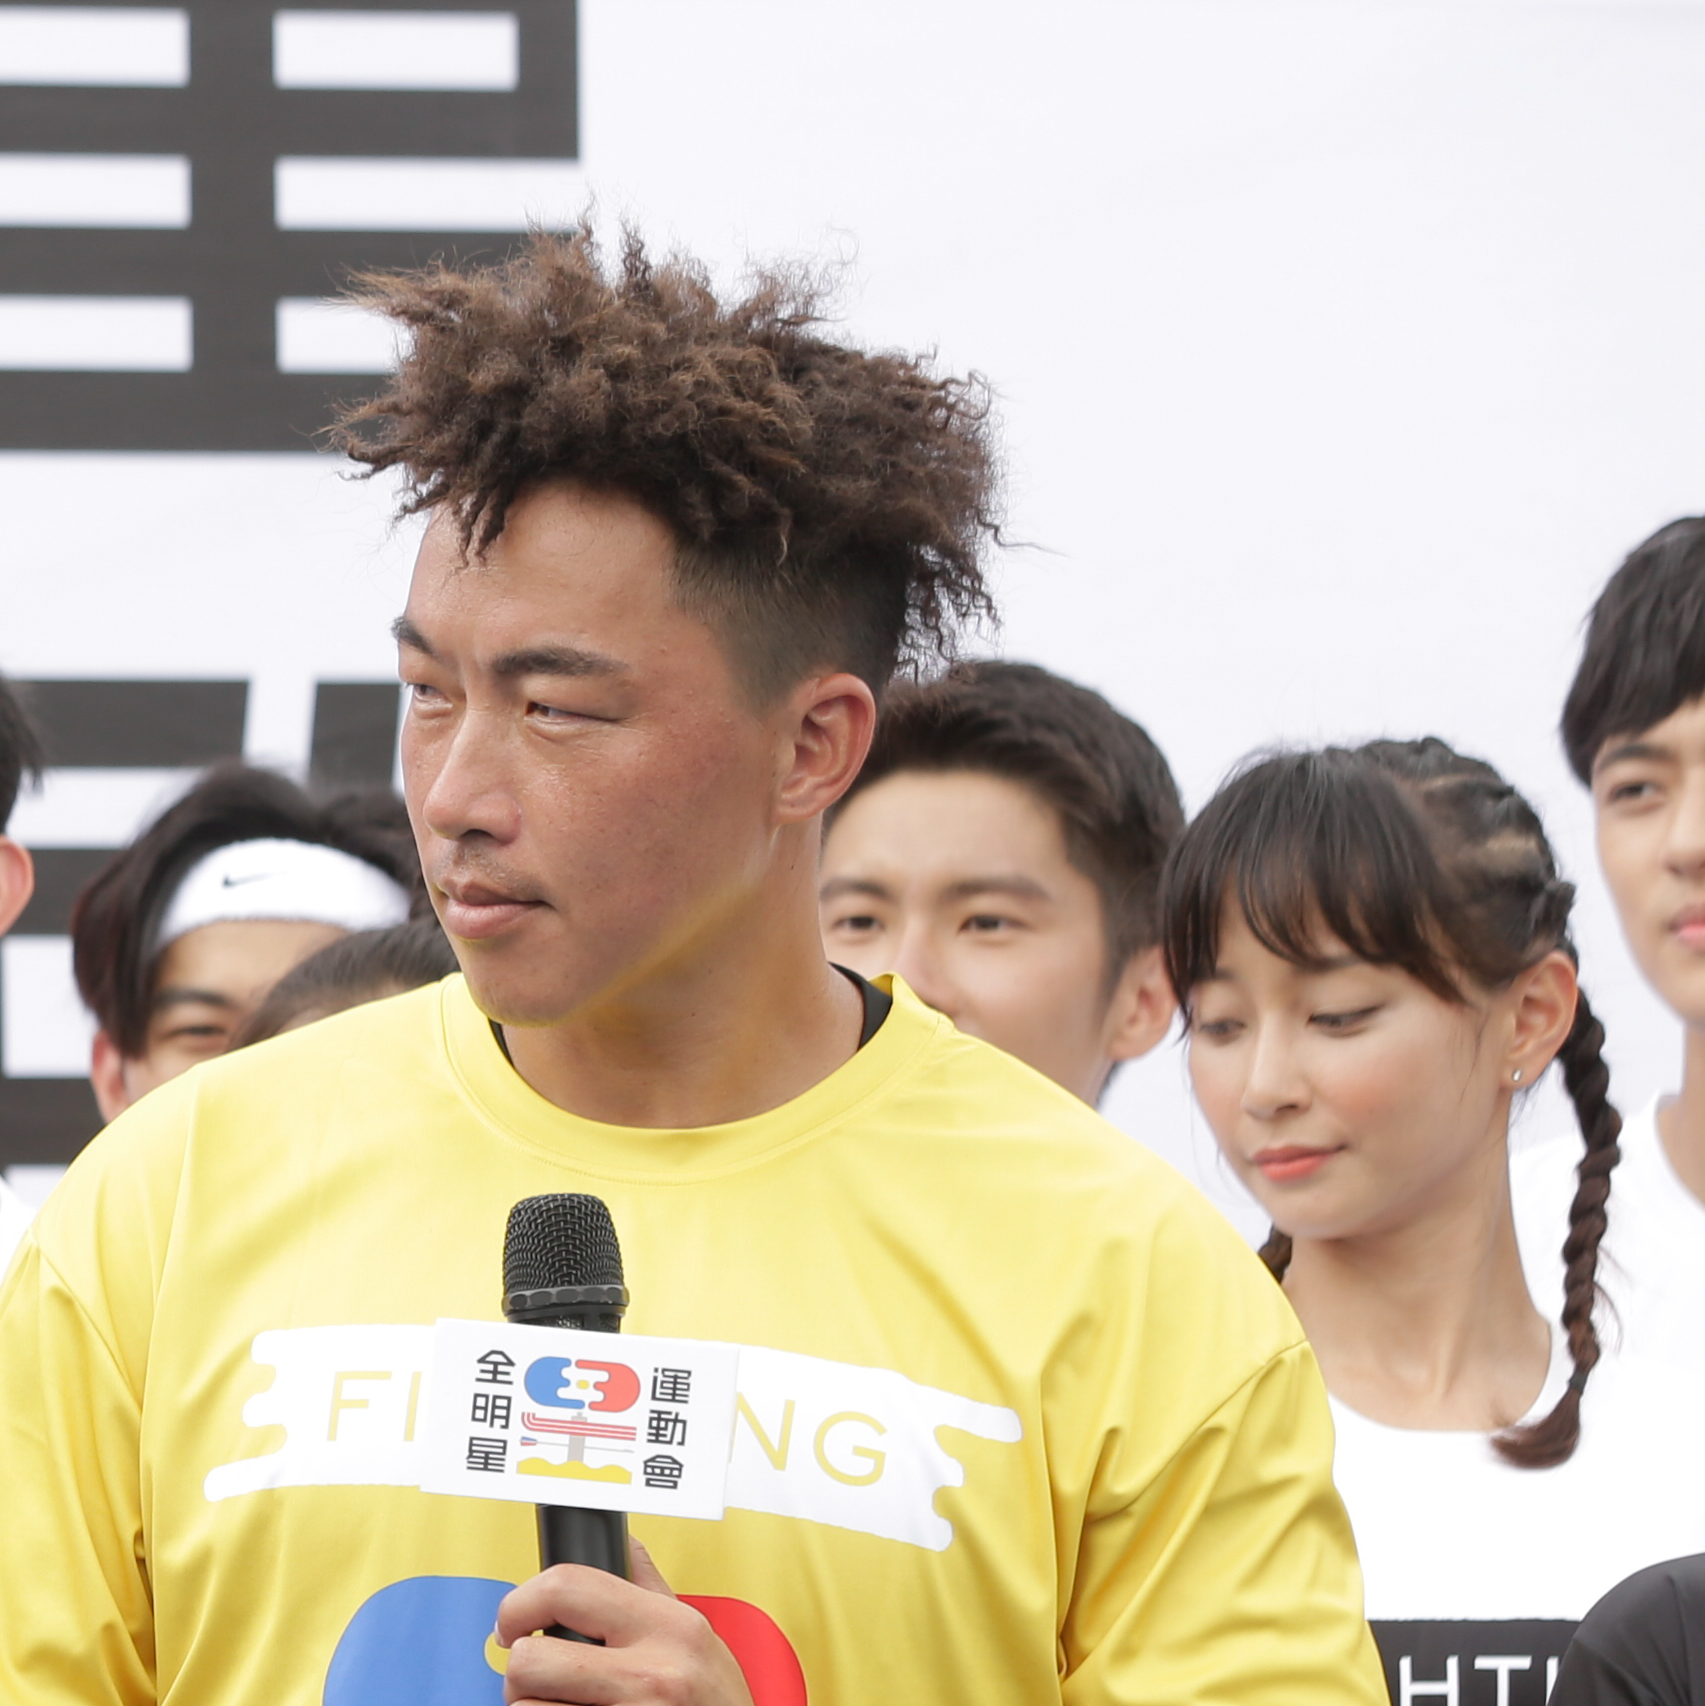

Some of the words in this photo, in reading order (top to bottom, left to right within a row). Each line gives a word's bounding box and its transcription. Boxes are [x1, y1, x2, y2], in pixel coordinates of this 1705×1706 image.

[466, 1350, 516, 1473] 全明星
[642, 1367, 692, 1490] 運動會
